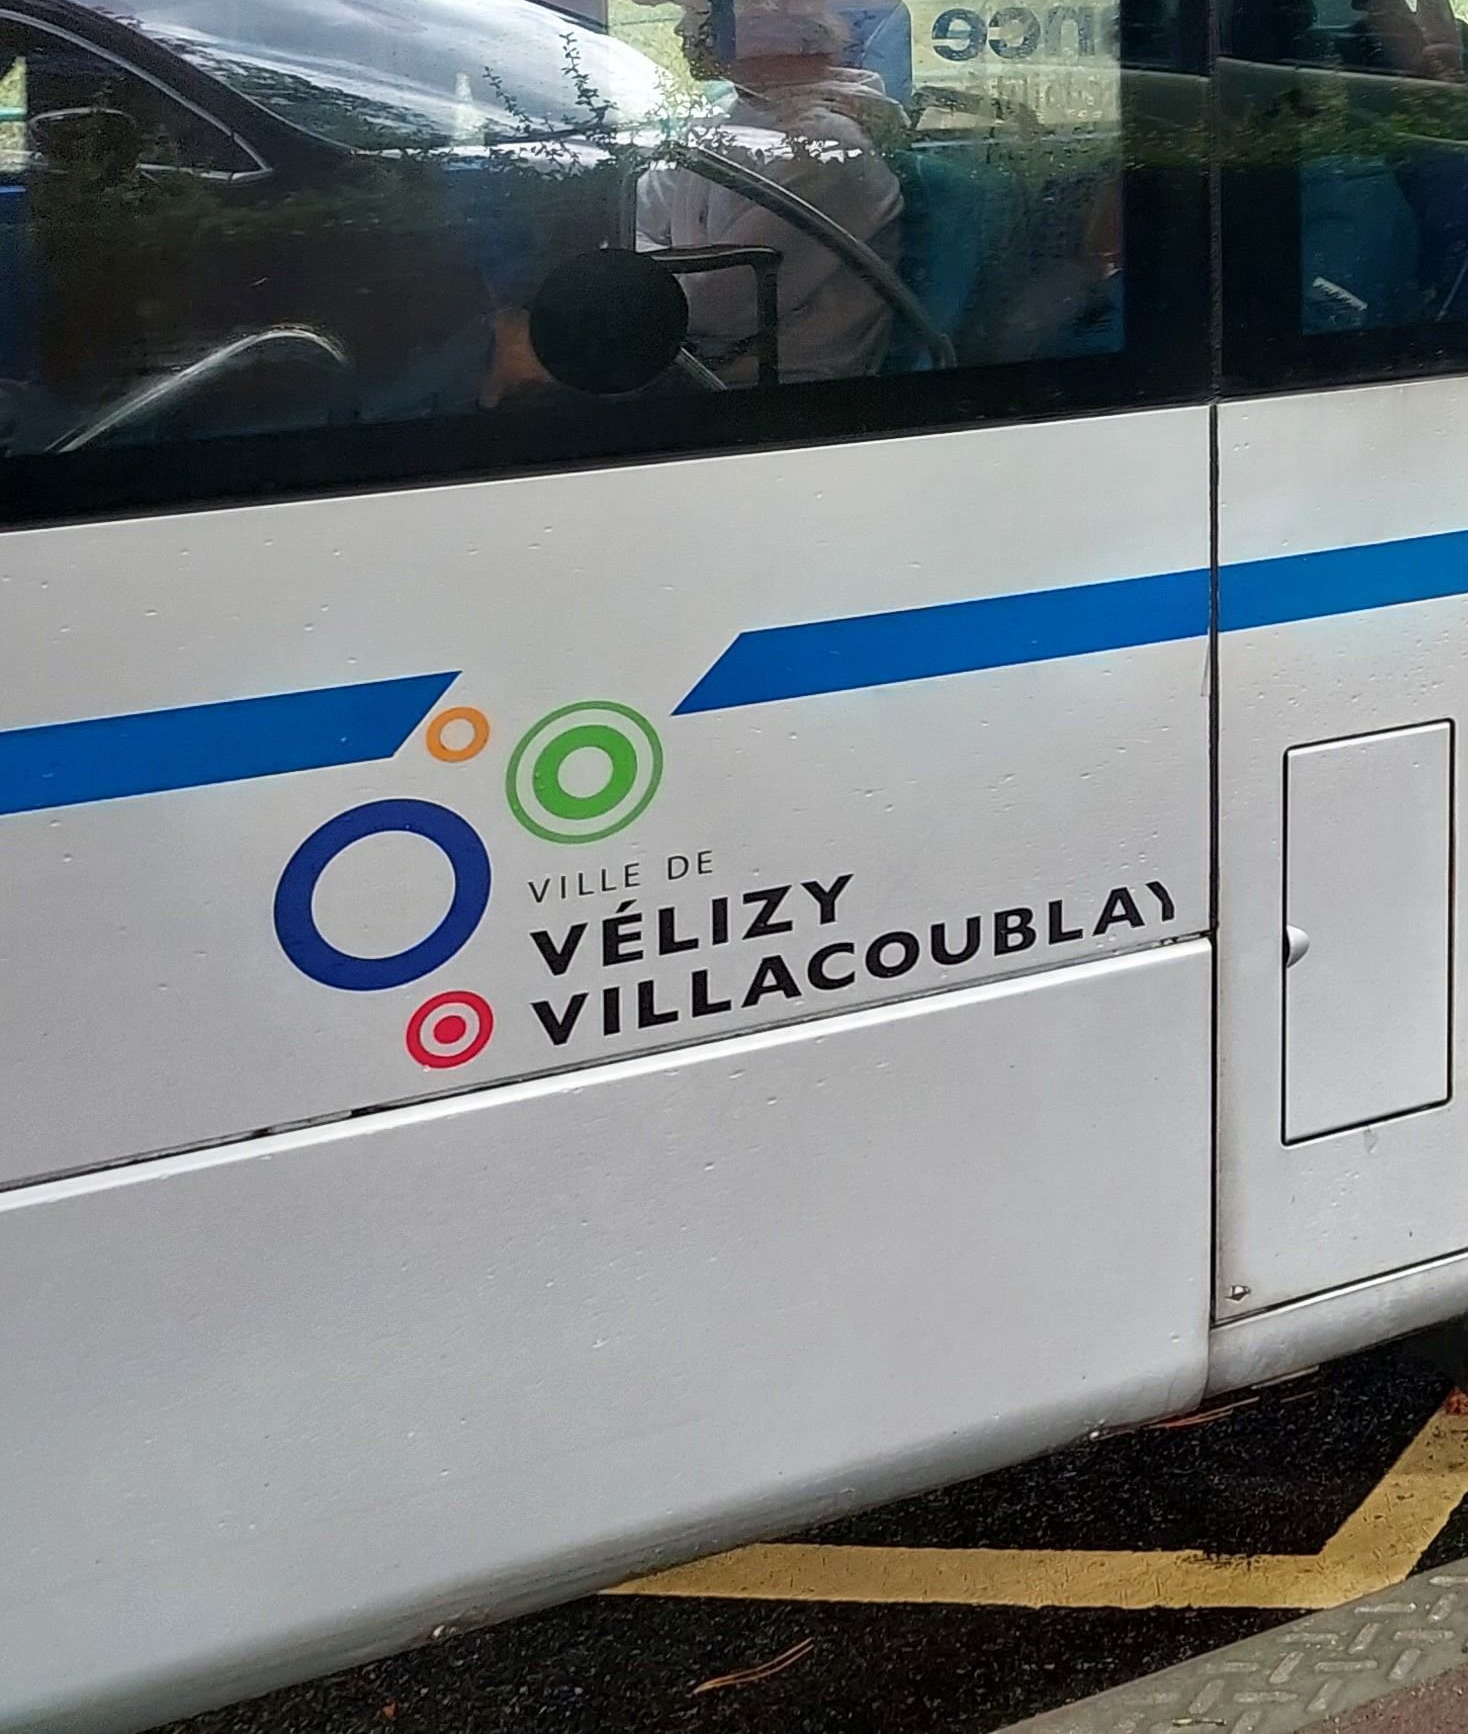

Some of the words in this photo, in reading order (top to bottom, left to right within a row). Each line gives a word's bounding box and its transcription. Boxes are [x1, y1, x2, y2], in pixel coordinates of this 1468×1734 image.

[527, 862, 641, 904] VILLE
[667, 849, 714, 881] DE
[529, 873, 855, 977] VÉLIZY
